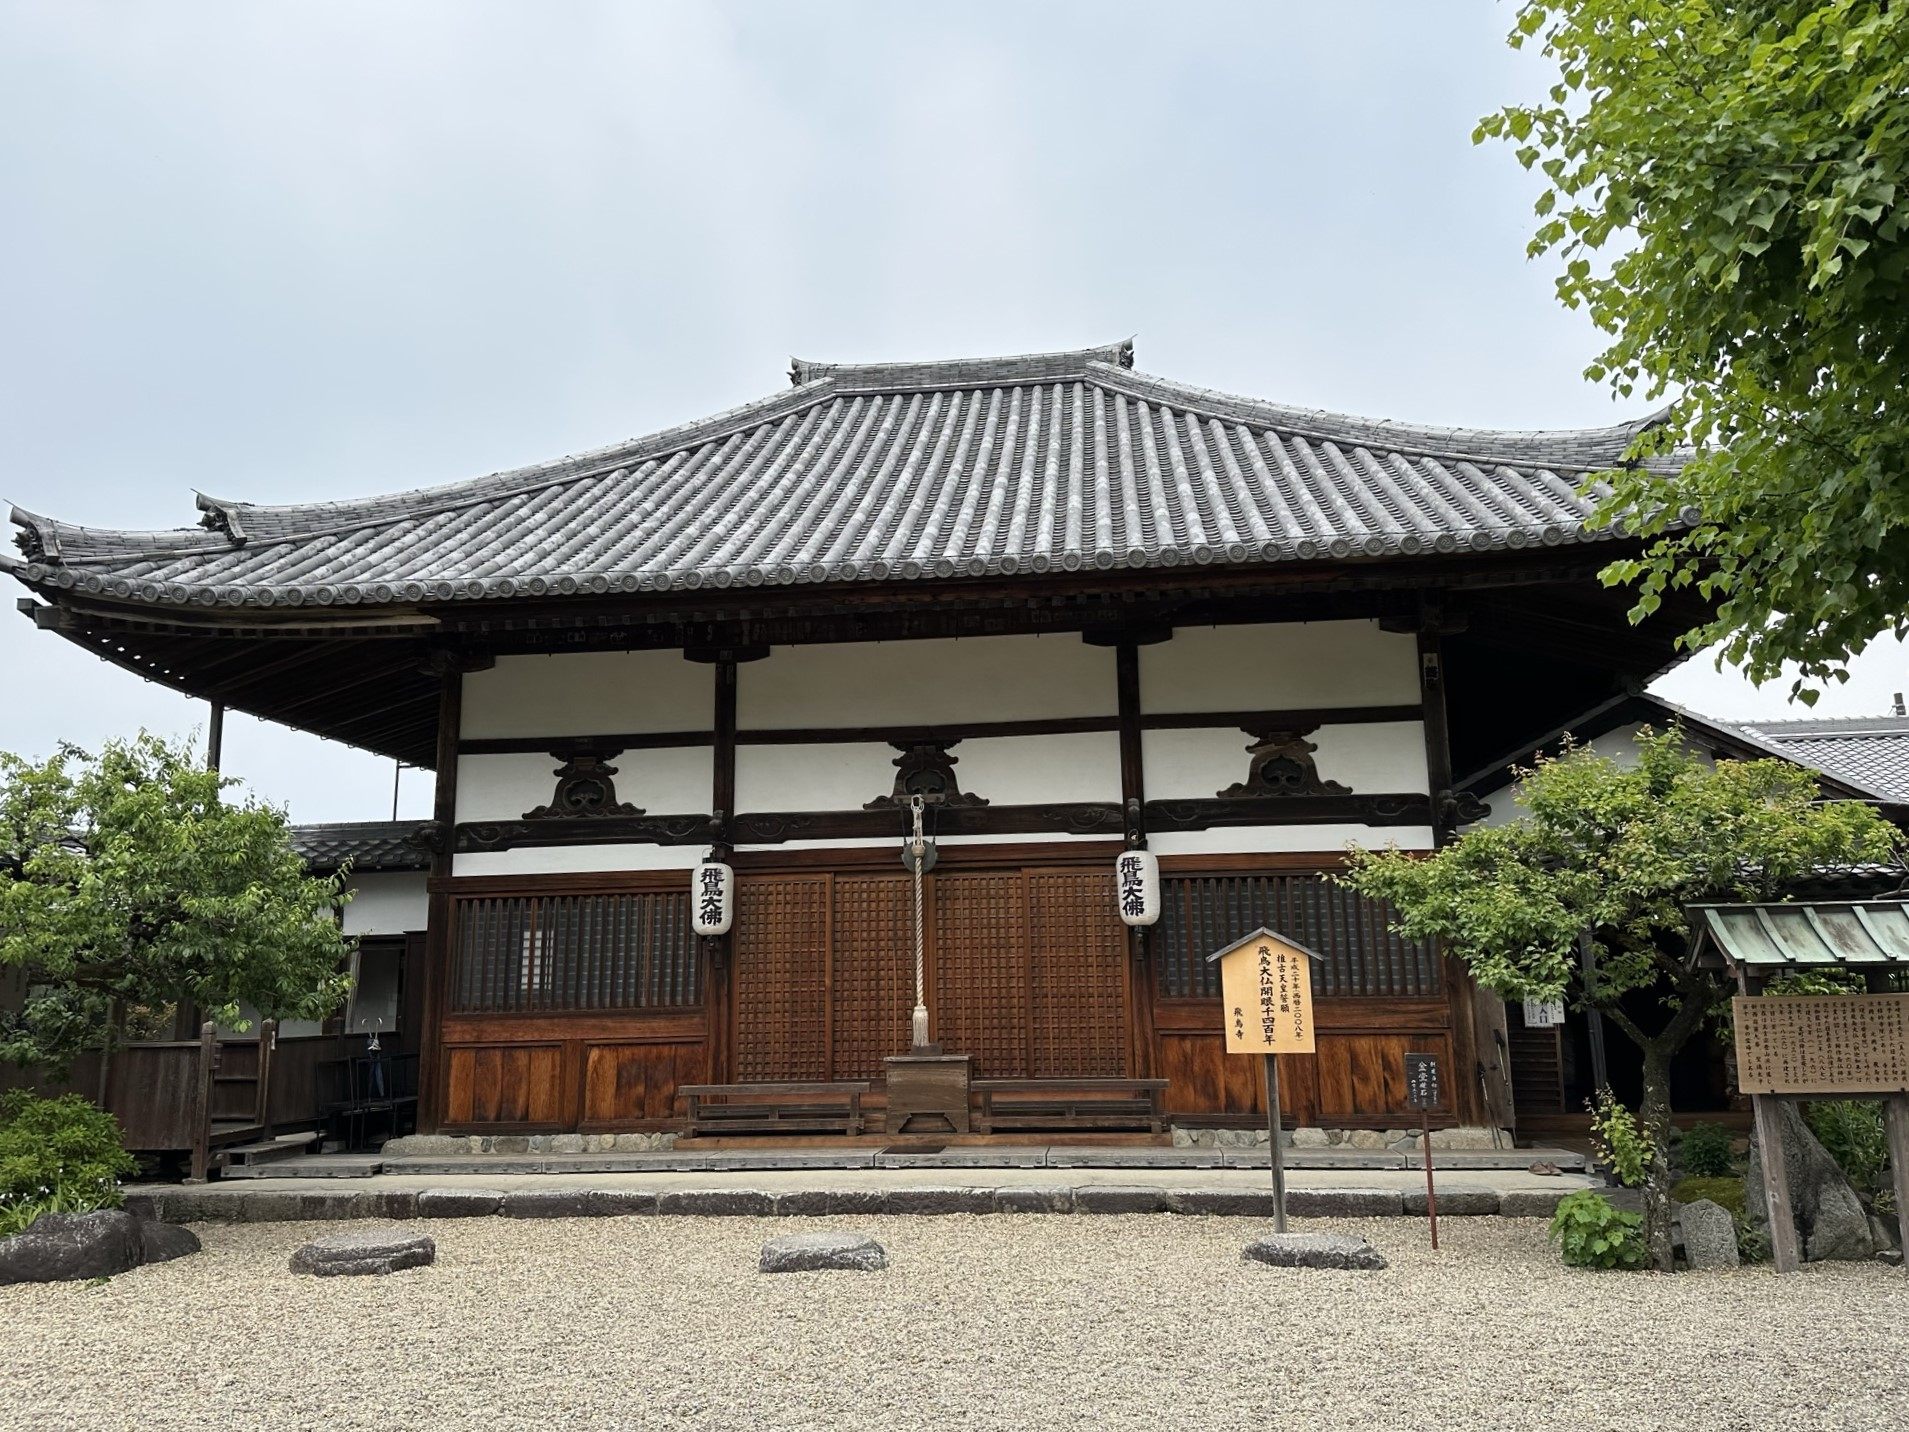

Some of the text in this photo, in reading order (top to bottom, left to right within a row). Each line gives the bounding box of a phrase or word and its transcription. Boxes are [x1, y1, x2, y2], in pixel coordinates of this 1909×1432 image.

[699, 868, 725, 926] 飛鳥大佛
[1120, 856, 1144, 917] 飛鳥大佛
[1257, 945, 1276, 1046] 飛鳥大仏開眼千四百年
[1276, 954, 1290, 1013] 推古天皇誓願
[1233, 1007, 1244, 1040] 飛鳥寺
